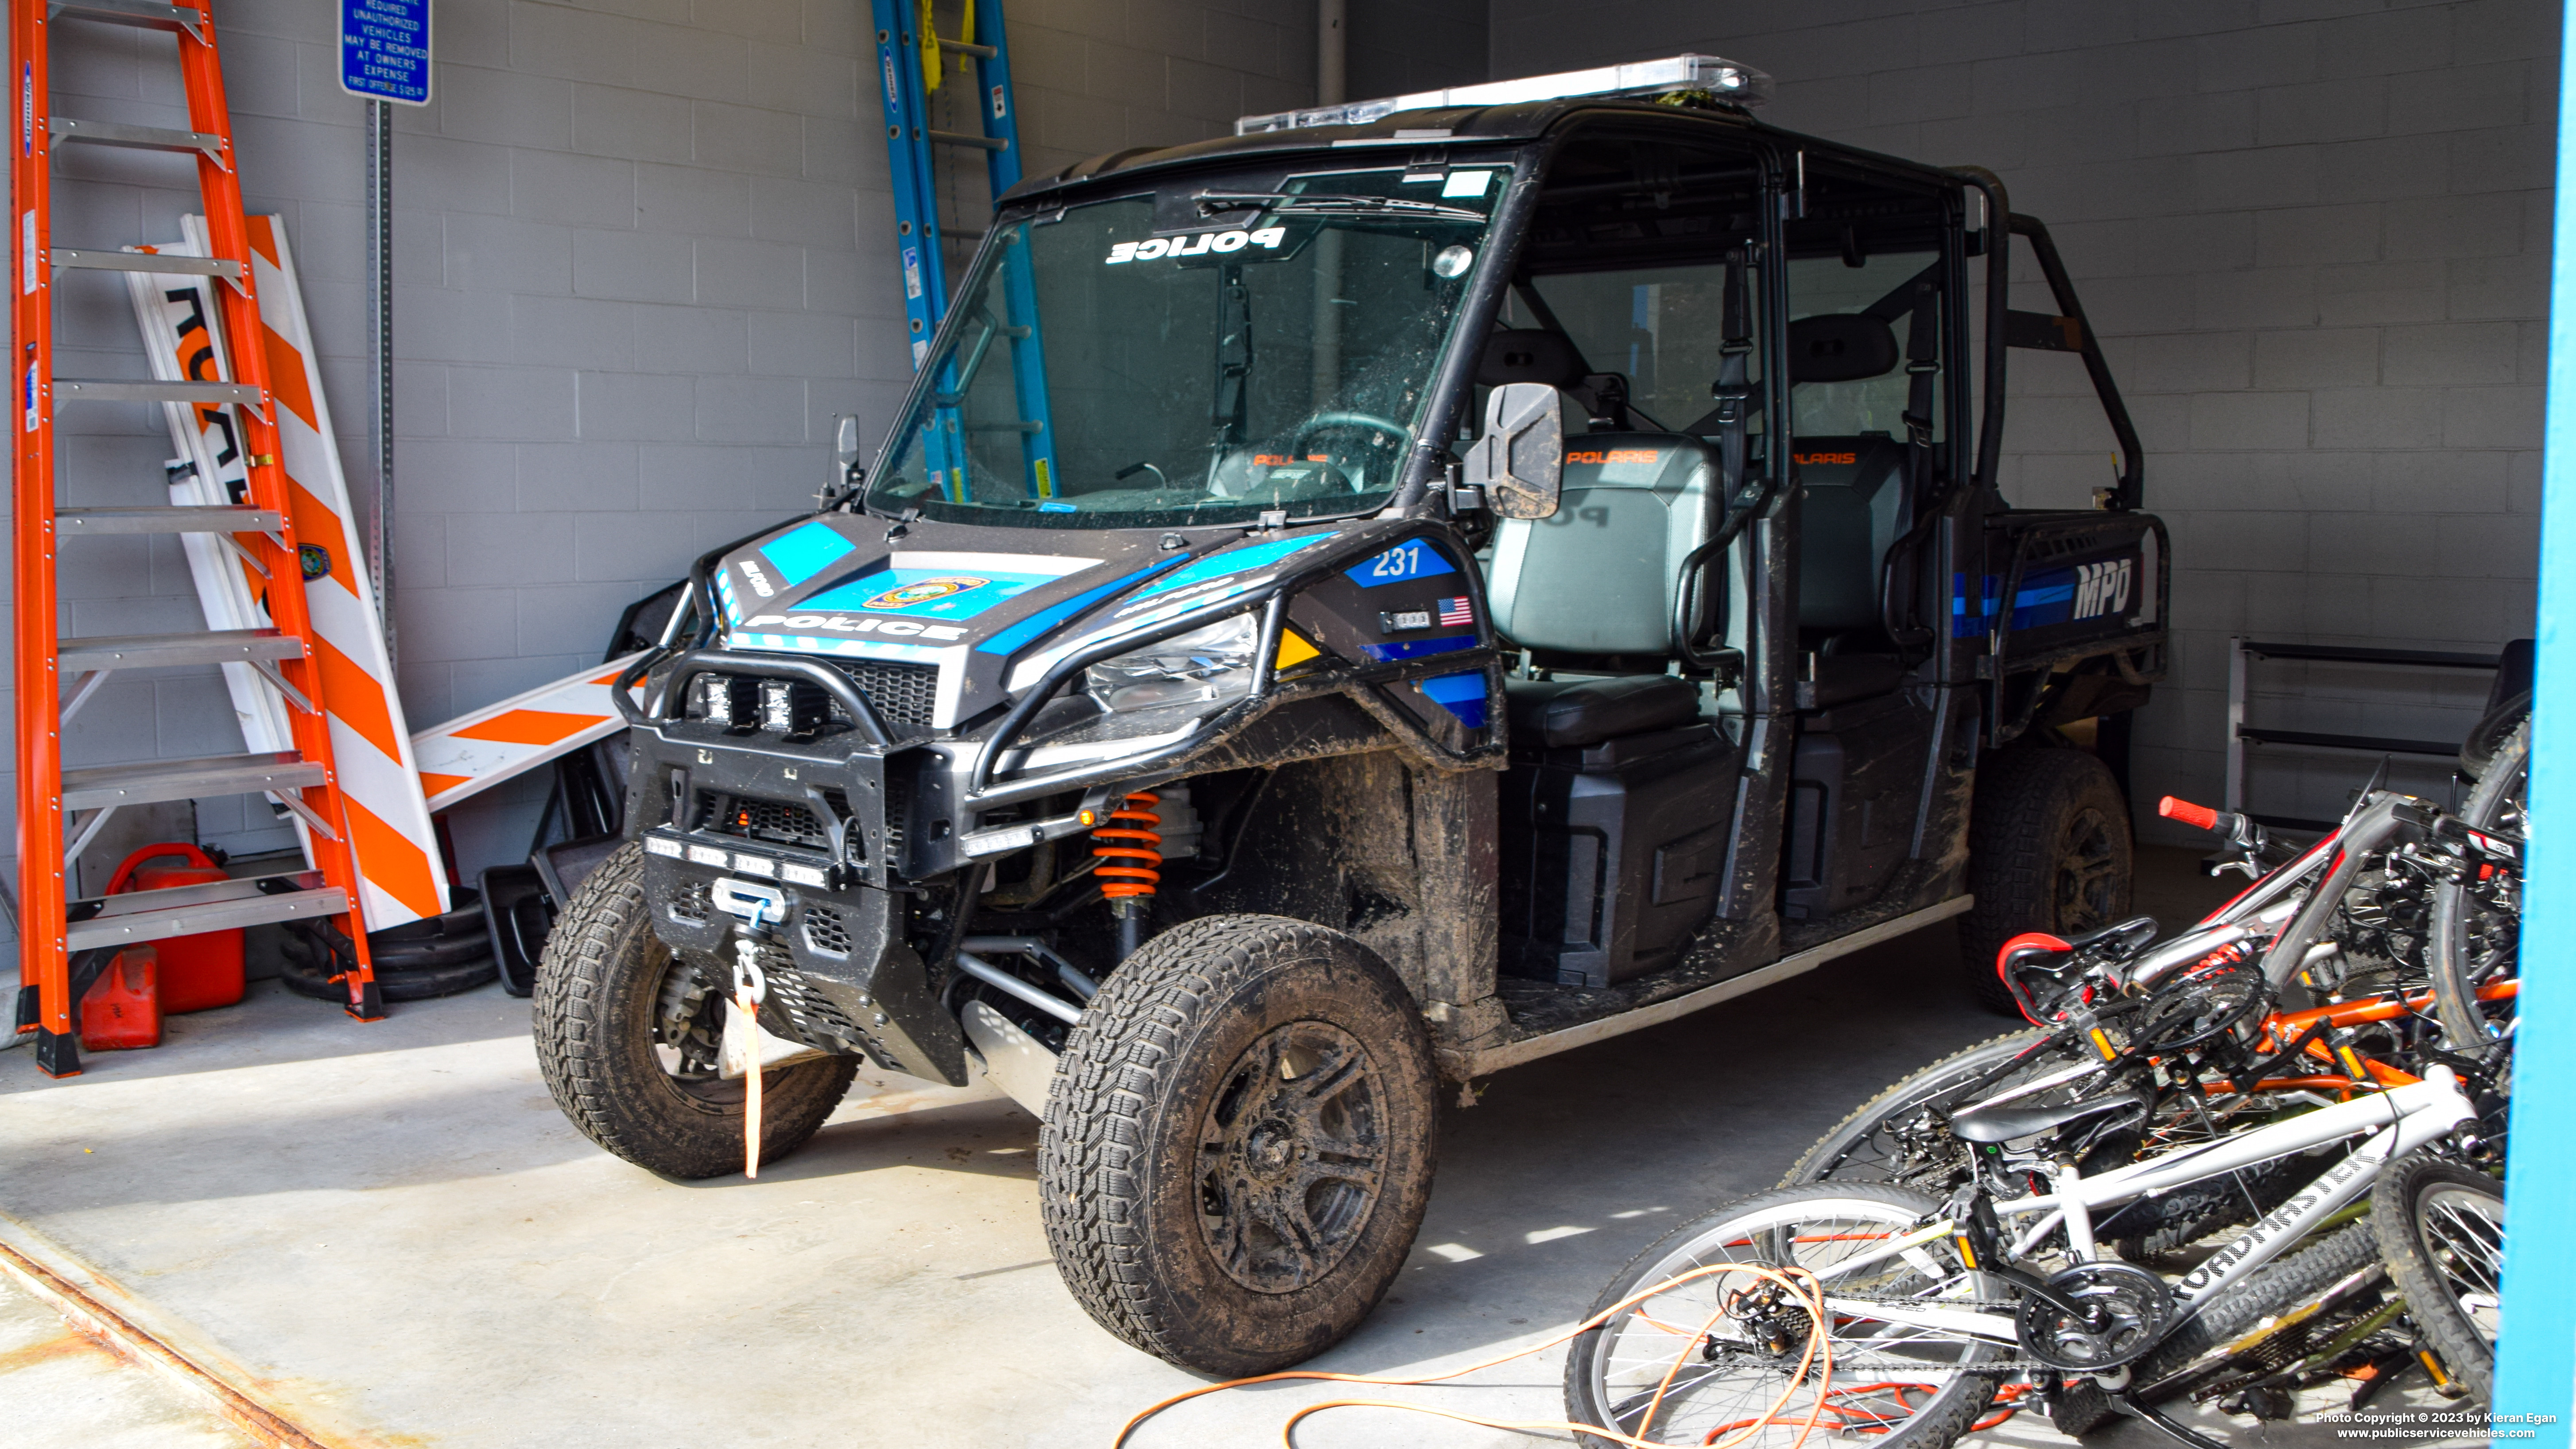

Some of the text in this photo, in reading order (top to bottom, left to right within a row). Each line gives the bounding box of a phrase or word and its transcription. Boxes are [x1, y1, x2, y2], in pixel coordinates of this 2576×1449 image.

[354, 8, 419, 31] UNAUTHORIZED
[366, 0, 407, 15] REQUIRED
[363, 24, 411, 43] VEHICLES
[344, 34, 428, 59] MAY BE REMOVED
[357, 50, 416, 70] AT OWNERS
[349, 76, 365, 86] FIRST
[365, 65, 409, 82] EXPENSE
[1566, 450, 1658, 464] POLARIS
[1373, 547, 1419, 576] 231
[739, 561, 774, 597] MILFORD
[2074, 559, 2131, 619] MPD
[1113, 577, 1234, 618] MILFORD
[745, 615, 969, 640] POLICE
[2171, 1149, 2376, 1301] ROADMASTER
